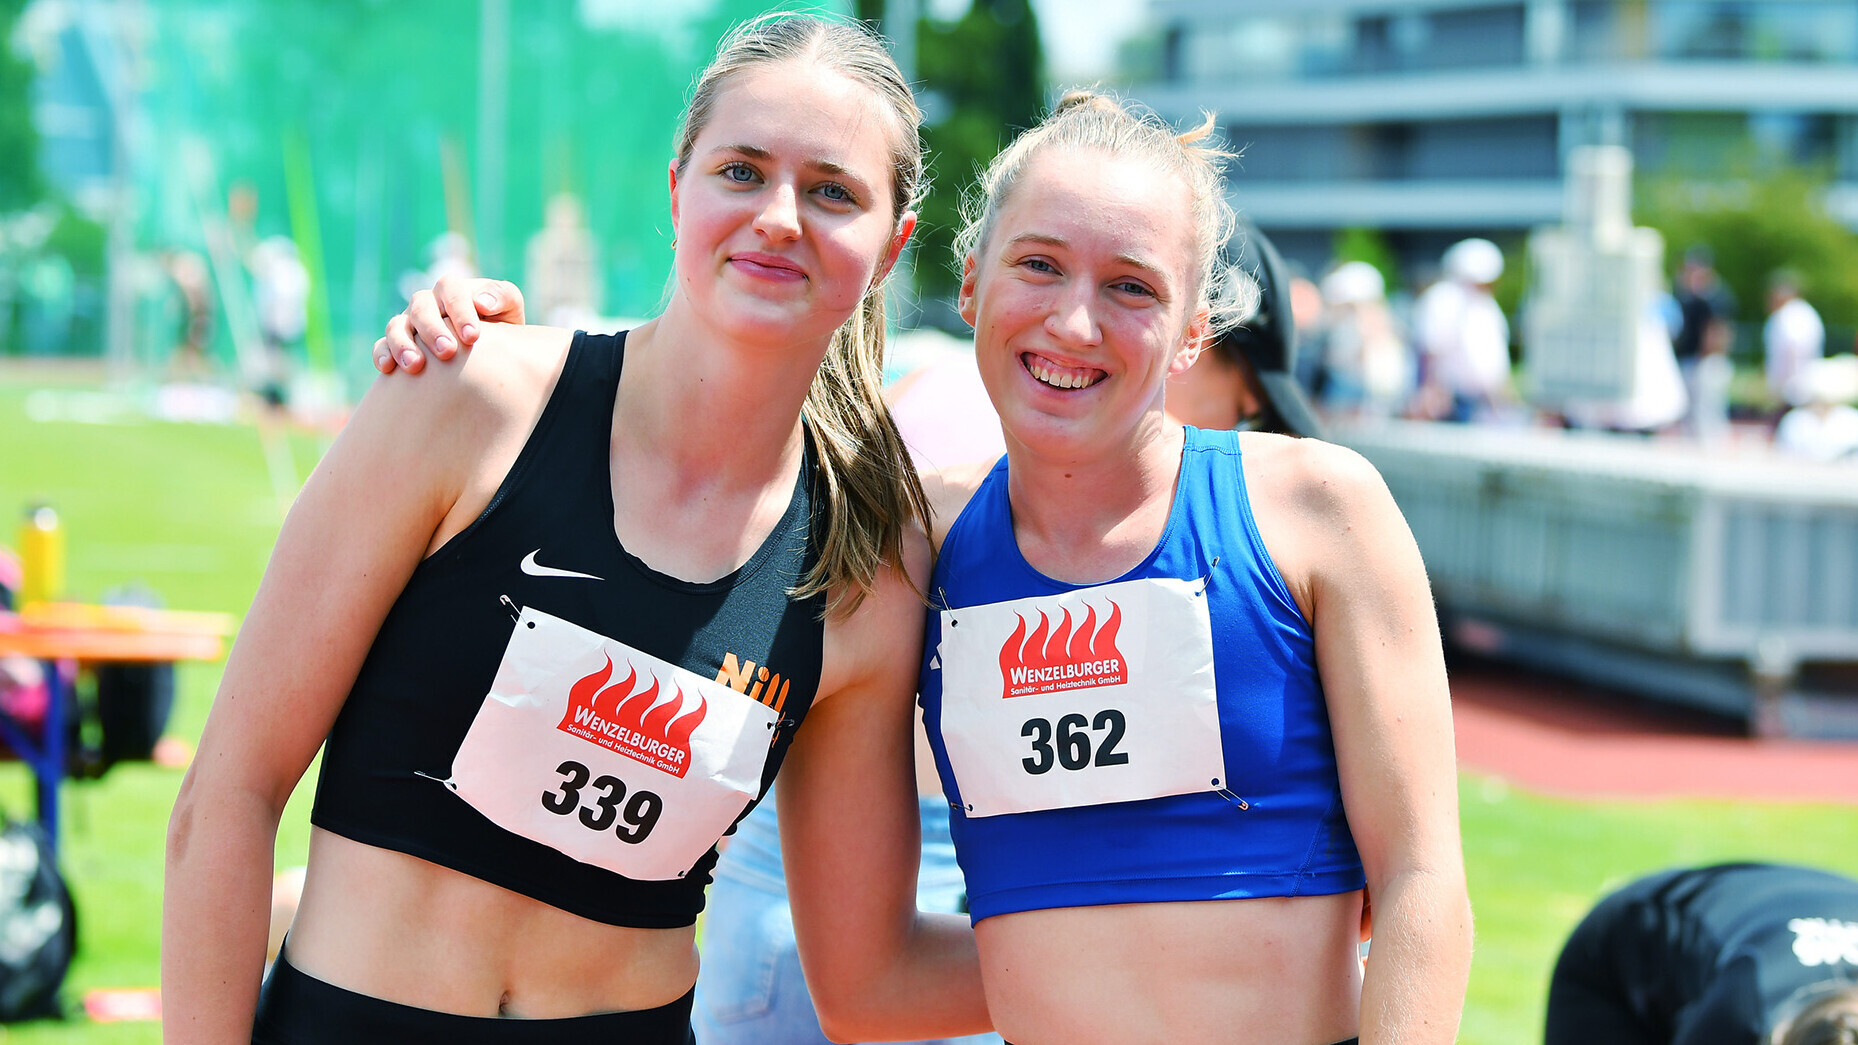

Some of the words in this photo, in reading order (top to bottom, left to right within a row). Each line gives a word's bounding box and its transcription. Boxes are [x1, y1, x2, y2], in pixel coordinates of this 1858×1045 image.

[1010, 685, 1039, 696] Sanitär-
[1040, 683, 1055, 693] und
[1056, 678, 1096, 690] Heiztechnik
[1097, 675, 1121, 685] GmbH
[566, 723, 597, 741] Sanitär-
[598, 737, 614, 748] und
[613, 742, 656, 765] Heiztechnik
[656, 759, 680, 774] GmbH
[1021, 709, 1129, 775] 362
[541, 761, 663, 844] 339
